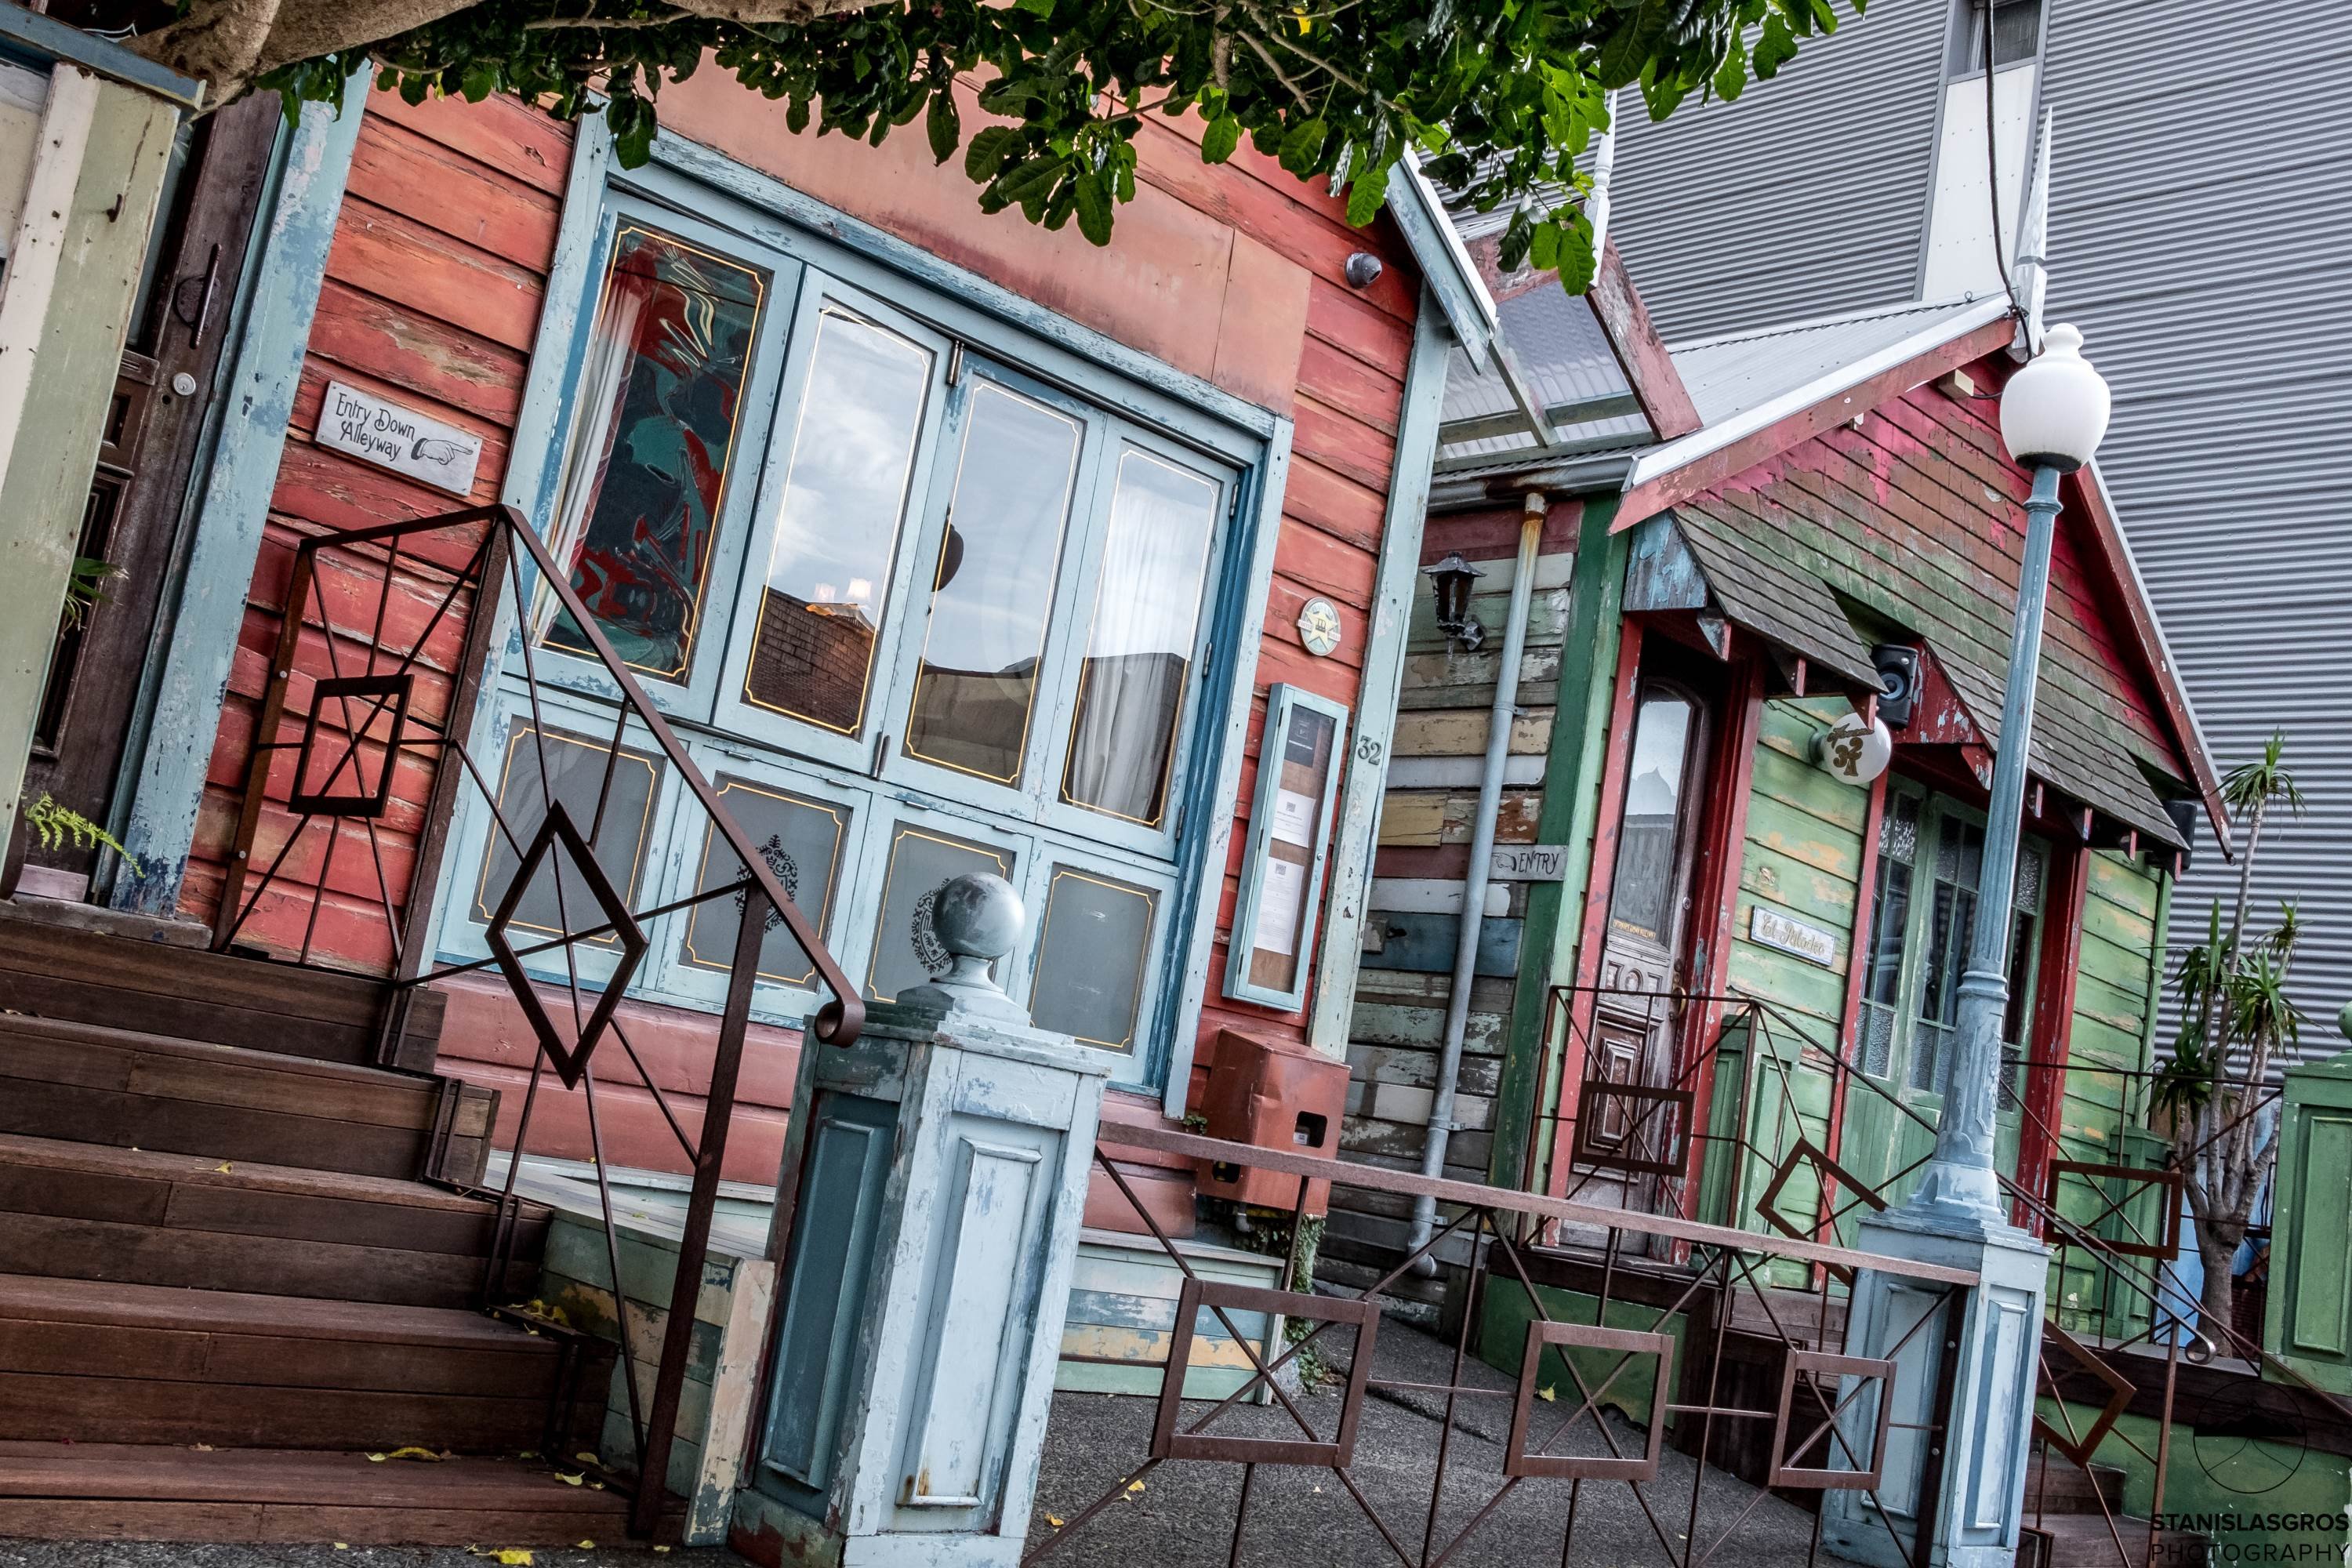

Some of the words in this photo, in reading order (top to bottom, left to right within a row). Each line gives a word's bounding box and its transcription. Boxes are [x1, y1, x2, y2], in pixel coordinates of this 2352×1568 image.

[336, 392, 372, 426] Entry
[374, 408, 416, 442] Down
[339, 419, 402, 462] Alleyway
[1357, 735, 1382, 766] 32
[1518, 850, 1560, 875] ENTRY
[1761, 913, 1778, 939] El
